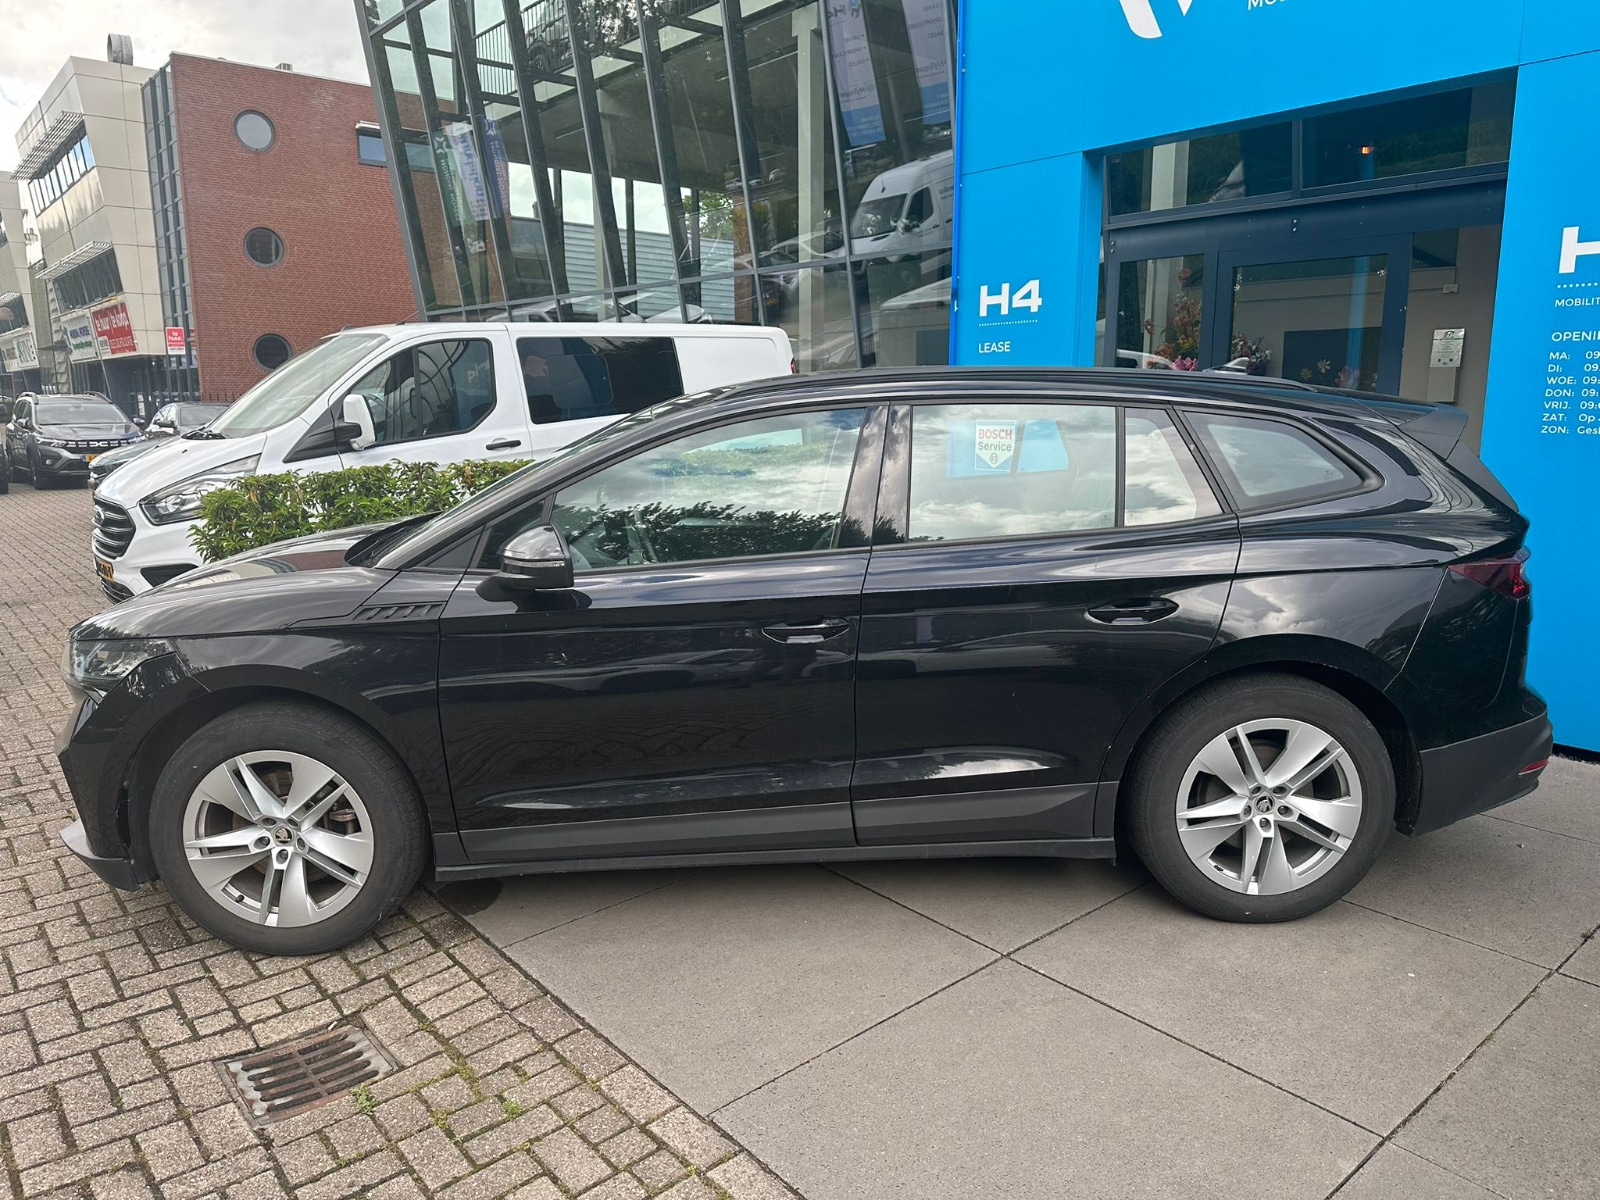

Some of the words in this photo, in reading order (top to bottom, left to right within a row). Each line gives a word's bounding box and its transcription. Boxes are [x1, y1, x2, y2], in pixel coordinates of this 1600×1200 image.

[979, 279, 1043, 317] H4
[978, 341, 1011, 354] LEASE
[1549, 351, 1571, 360] MA:
[1585, 350, 1600, 359] 09
[1547, 364, 1562, 373] DI:
[1583, 363, 1600, 372] 09
[1546, 376, 1577, 385] WOE:
[1545, 388, 1575, 397] DON:
[1542, 413, 1567, 422] ZAT:
[1578, 413, 1596, 424] Op
[978, 429, 1012, 440] BOSCH
[1540, 425, 1569, 434] ZON:
[977, 441, 1012, 452] Service
